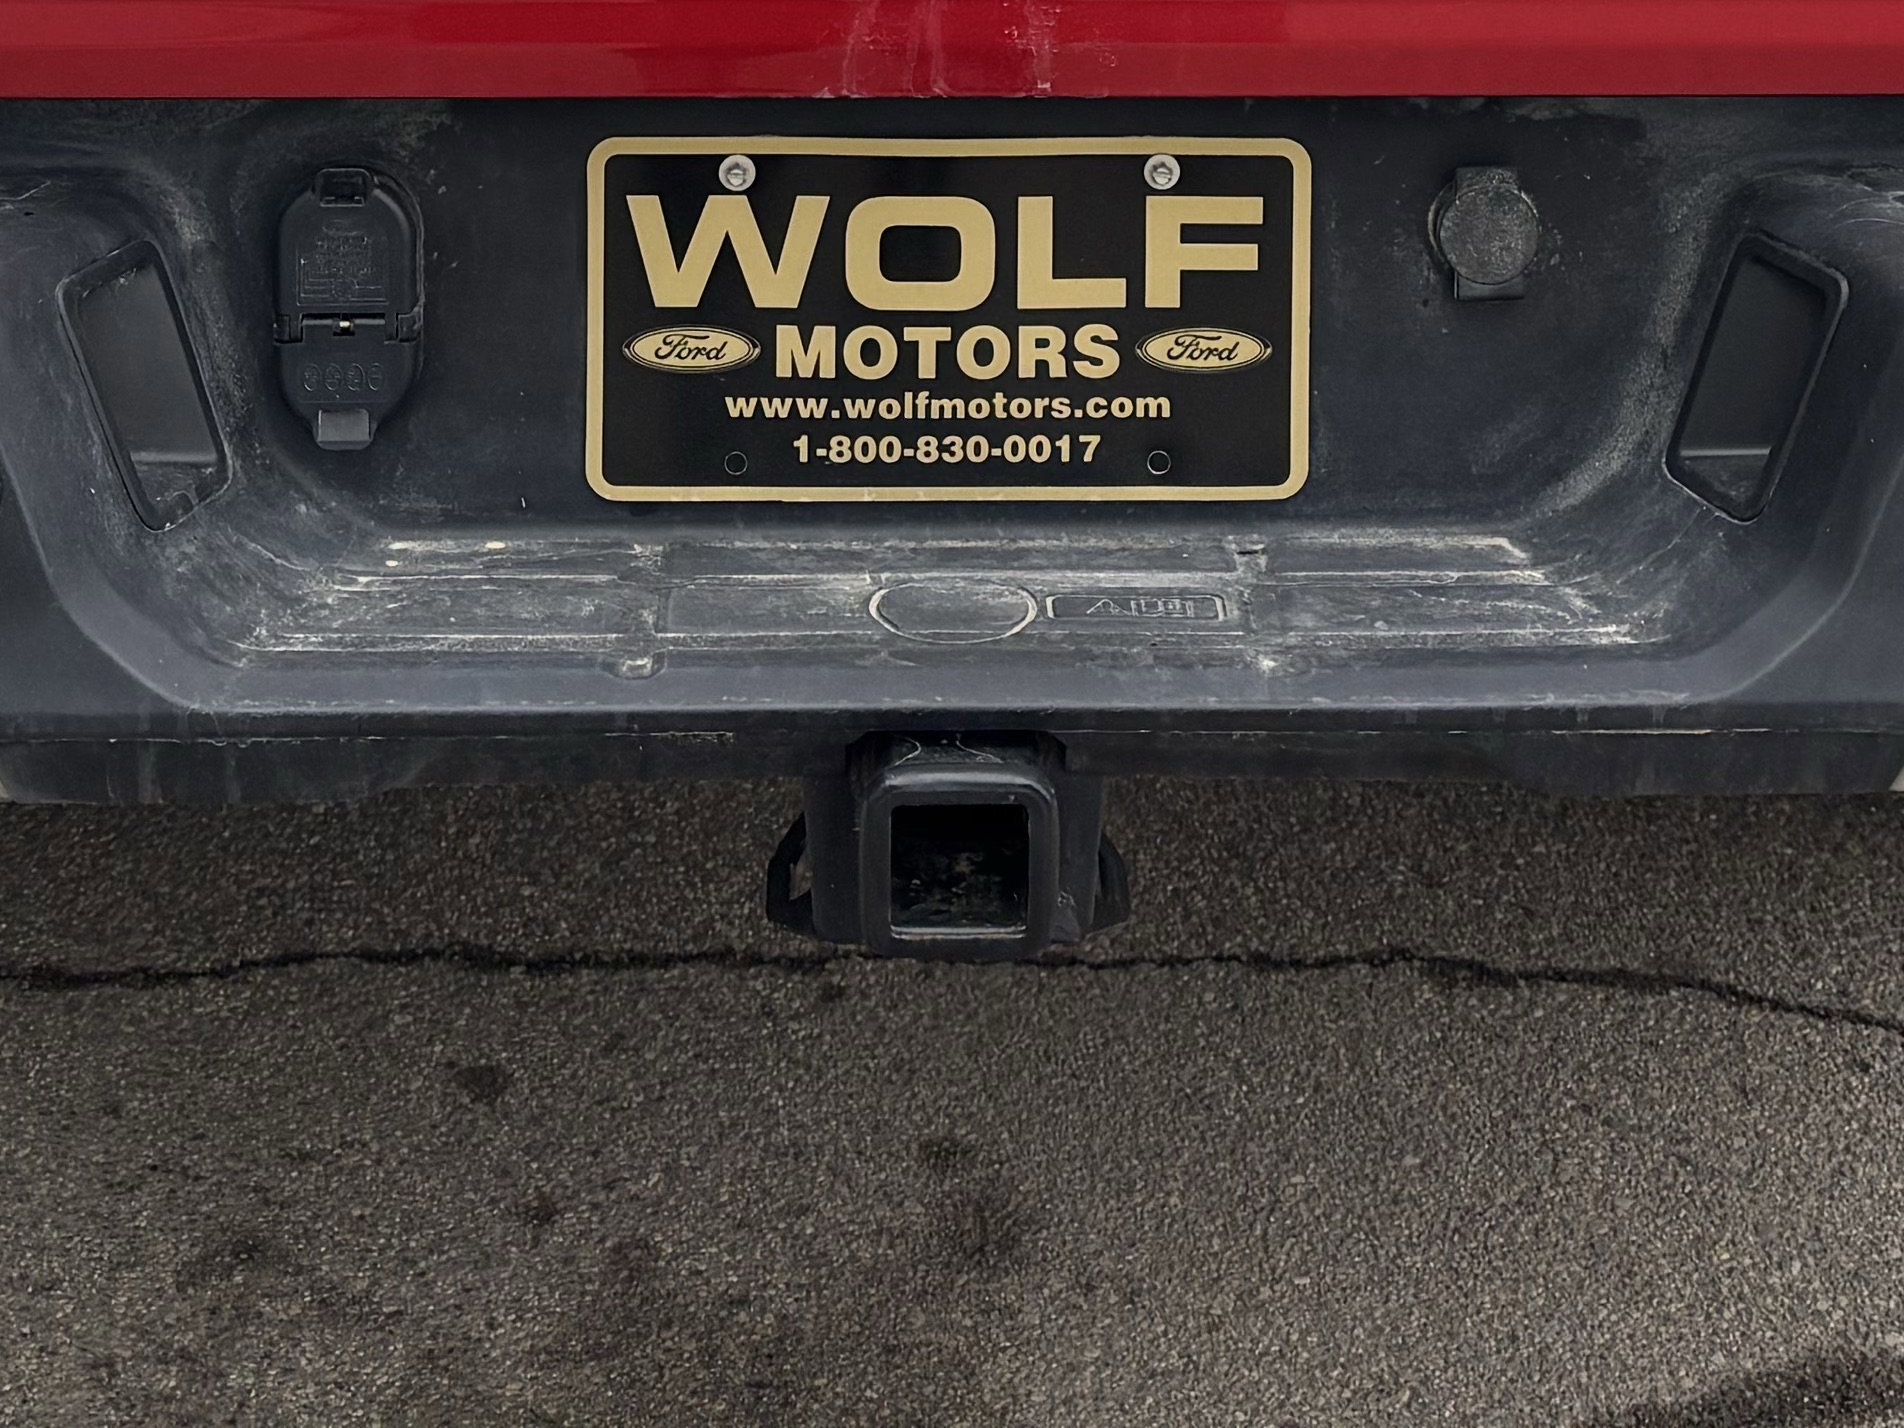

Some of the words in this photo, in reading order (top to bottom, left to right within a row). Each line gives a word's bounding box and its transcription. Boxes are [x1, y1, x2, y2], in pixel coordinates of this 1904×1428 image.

[625, 194, 1264, 311] WOLF
[653, 332, 728, 363] Ford
[774, 324, 1121, 380] MOTORS
[1165, 332, 1241, 363] Ford
[724, 390, 1171, 420] www.wolfmotors.com
[792, 434, 1102, 464] 1-800-830-0017
